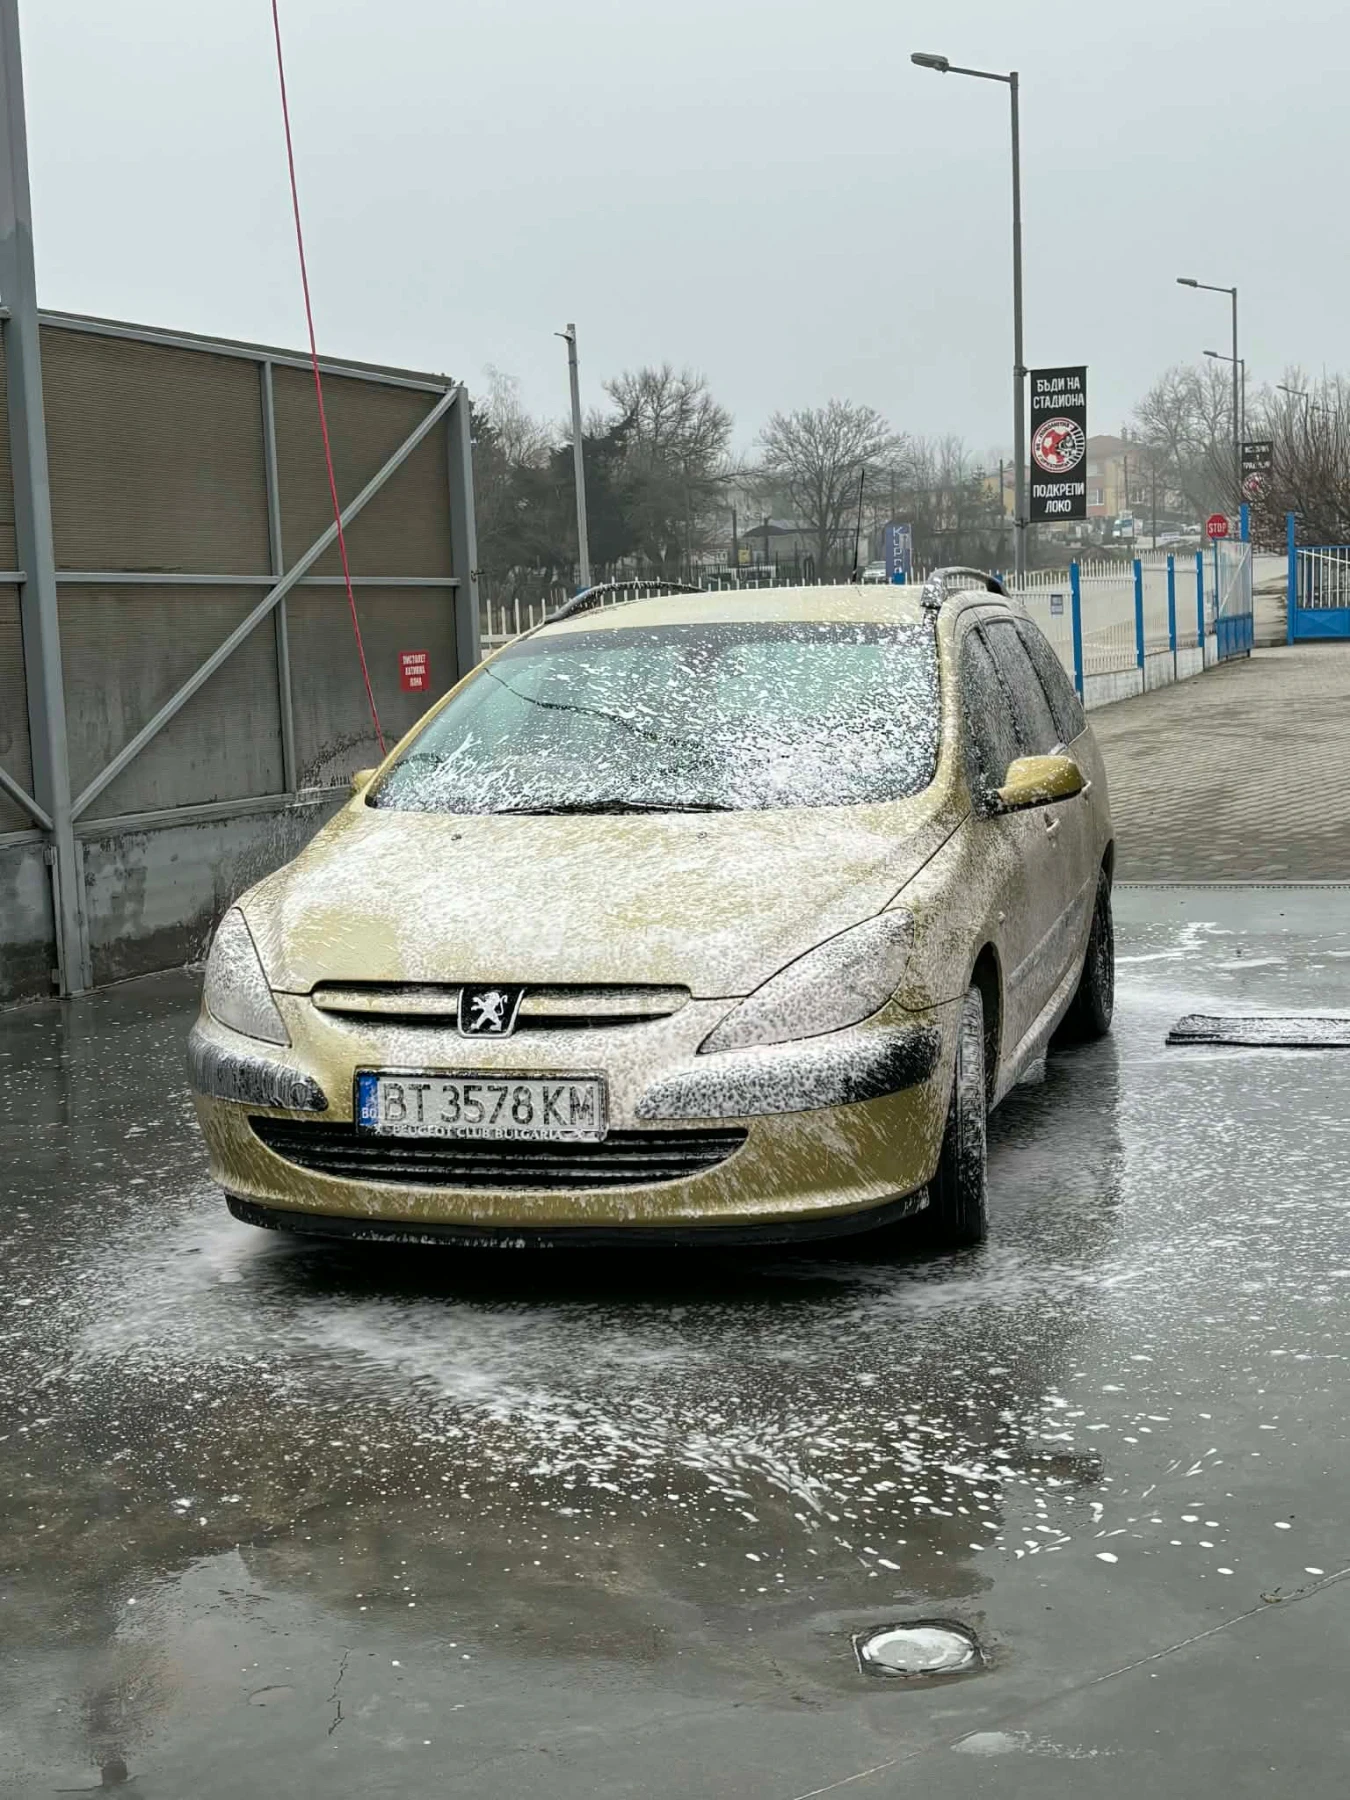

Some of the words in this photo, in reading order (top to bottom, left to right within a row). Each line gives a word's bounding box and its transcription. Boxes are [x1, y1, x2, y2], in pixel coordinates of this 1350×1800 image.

[1036, 378, 1066, 393] БЪДИ
[1067, 376, 1081, 390] НА
[1033, 393, 1085, 409] СТАДИОНА
[1033, 482, 1085, 498] ПОДКРЕПИ
[1045, 500, 1072, 513] ЛОКО
[1208, 523, 1227, 533] STOP
[384, 1083, 431, 1122] BT
[441, 1084, 534, 1125] 3578
[543, 1086, 594, 1126] KM
[393, 1125, 451, 1137] PEUGEOT
[457, 1128, 491, 1139] CLUB
[495, 1129, 562, 1141] BULGARIA
